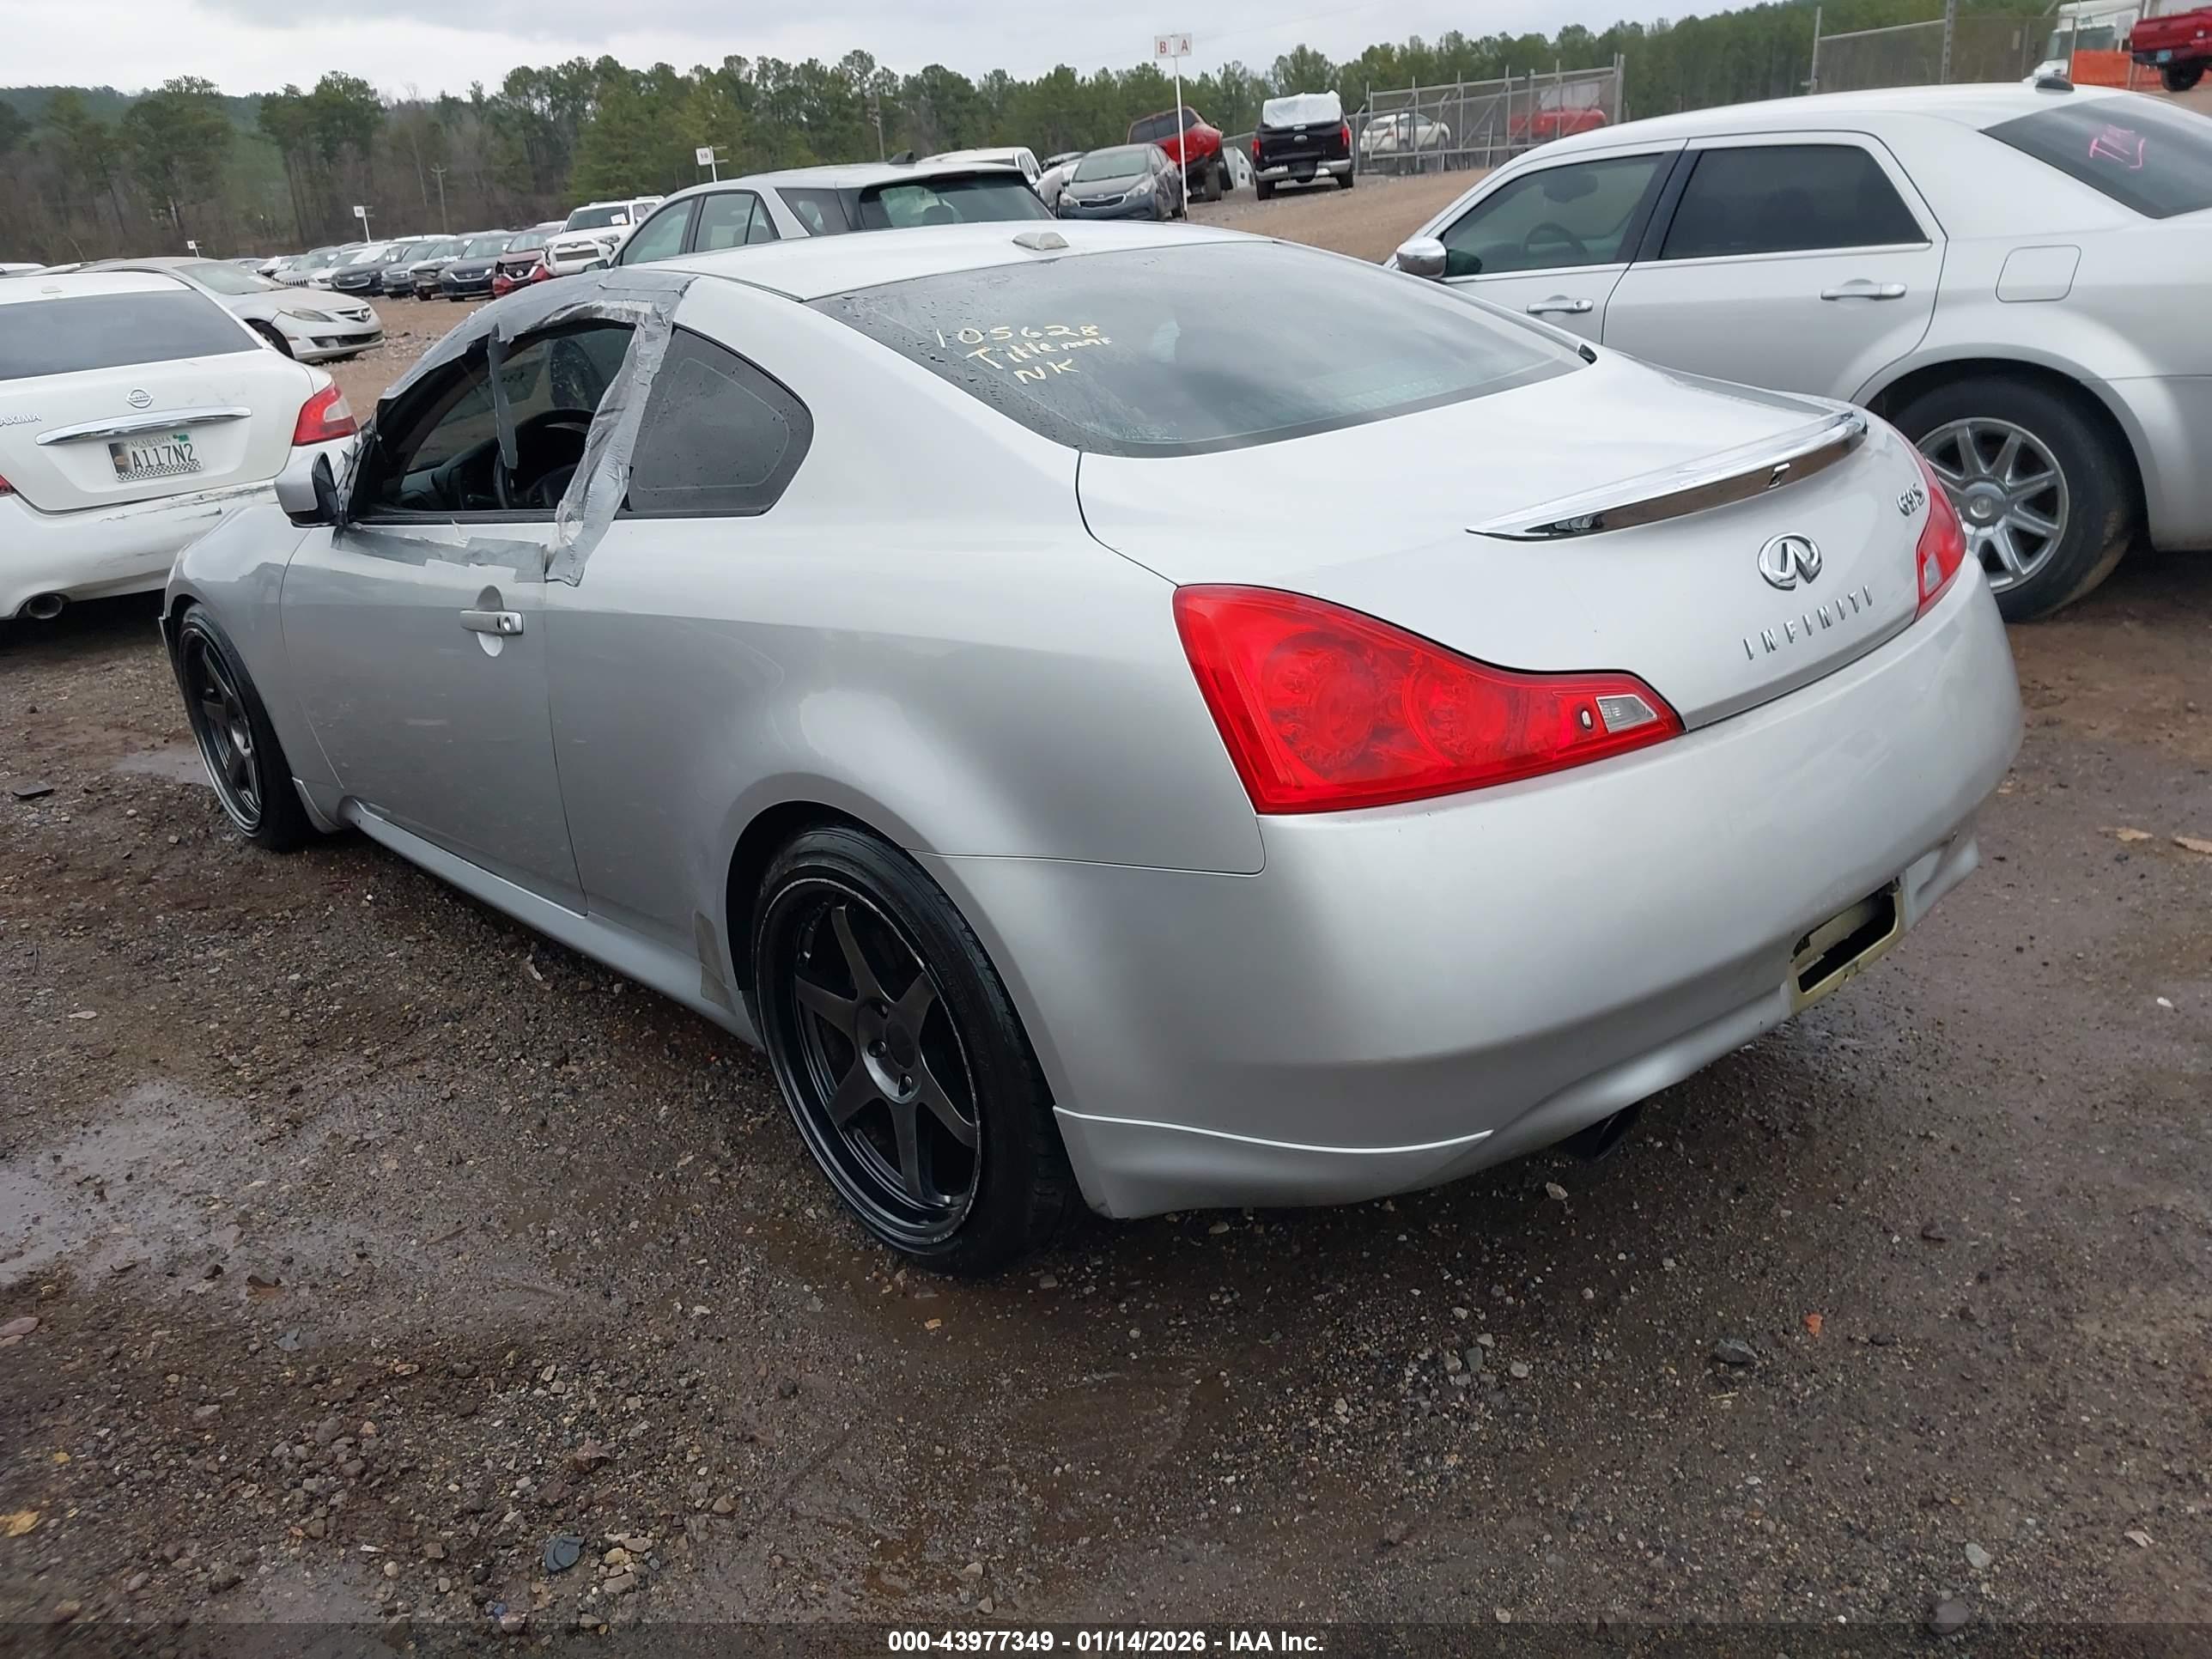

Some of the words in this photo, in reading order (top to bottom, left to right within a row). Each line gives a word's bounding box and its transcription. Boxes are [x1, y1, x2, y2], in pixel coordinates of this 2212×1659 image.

[1159, 40, 1167, 53] B
[1181, 39, 1189, 52] A
[936, 325, 1098, 348] 105628
[0, 412, 41, 427] AXIMA
[1743, 586, 1872, 659] INFINITI
